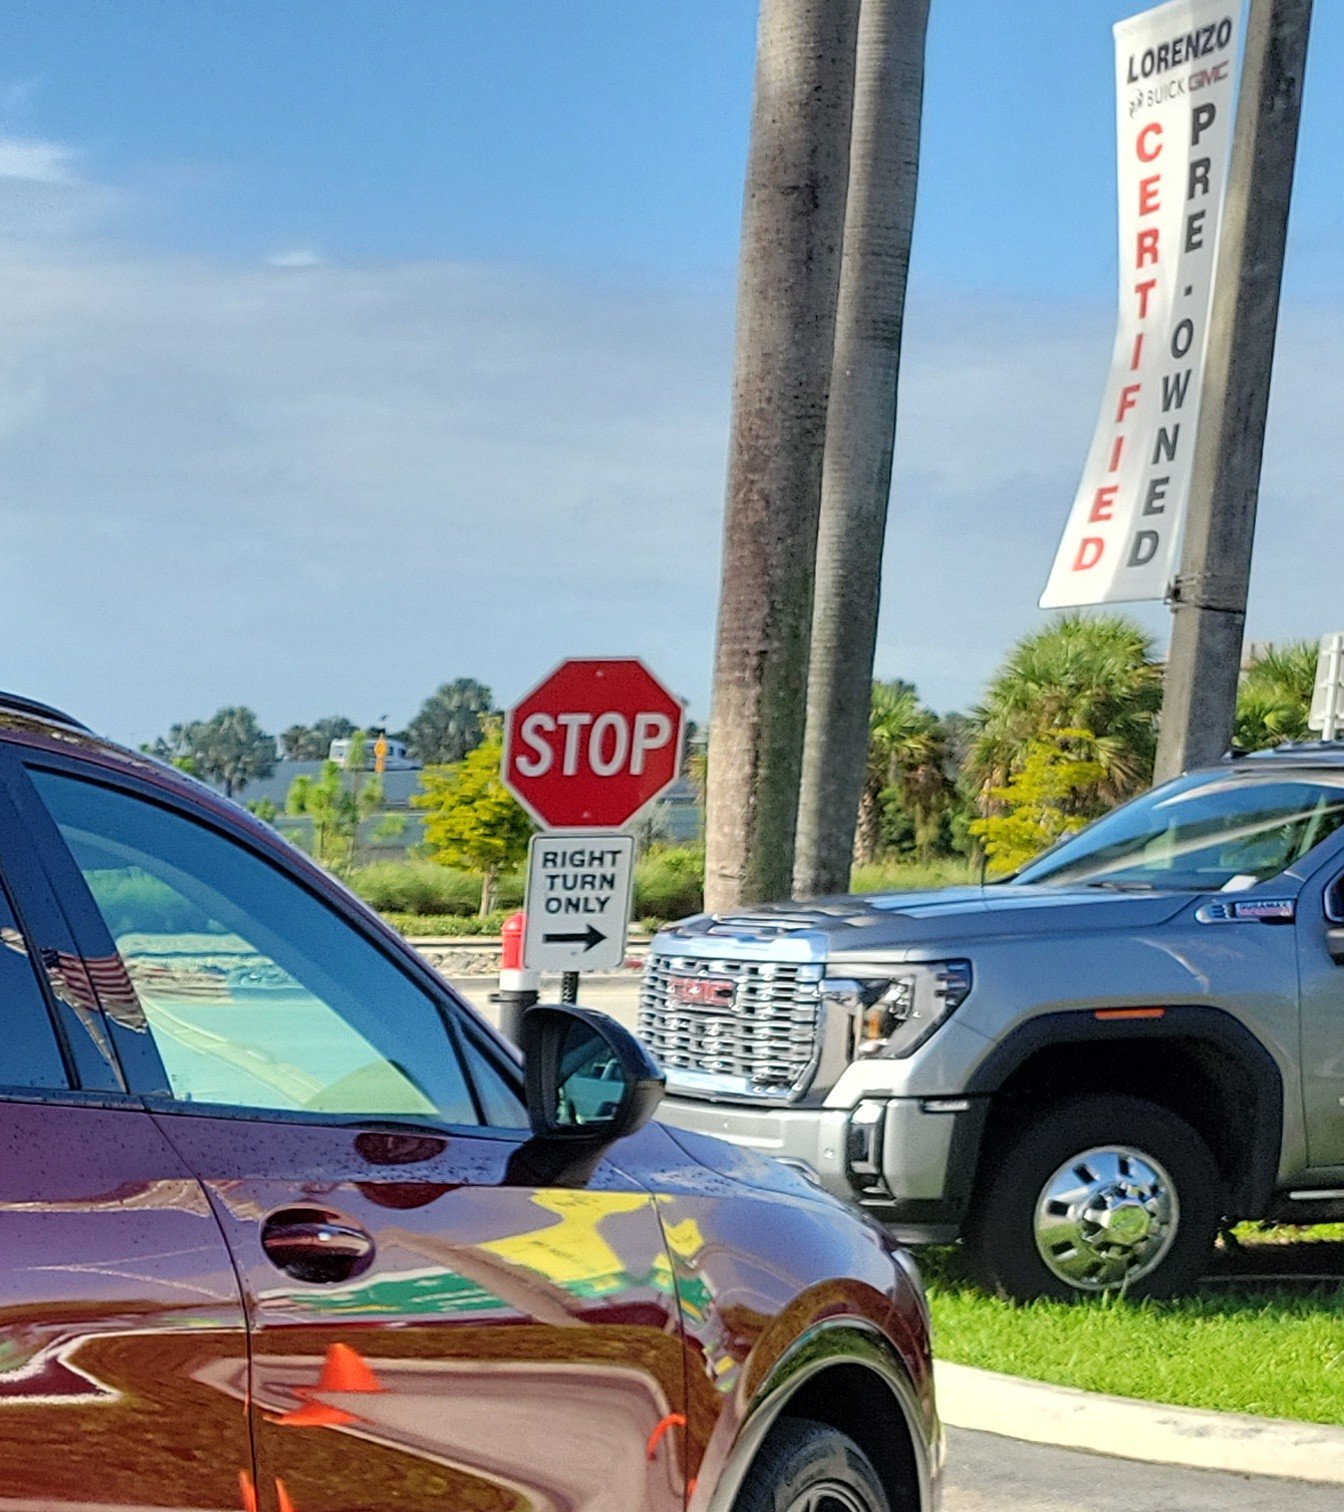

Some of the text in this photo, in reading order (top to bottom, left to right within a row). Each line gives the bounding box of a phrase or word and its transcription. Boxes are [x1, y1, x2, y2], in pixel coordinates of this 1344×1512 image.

[1127, 15, 1232, 84] LORENZO
[1147, 60, 1230, 107] BUICK GMC
[1072, 121, 1163, 572] CERTIFIED
[515, 712, 671, 777] STOP
[543, 849, 622, 869] RIGHT
[545, 872, 615, 891] TURN
[545, 896, 611, 914] ONLY
